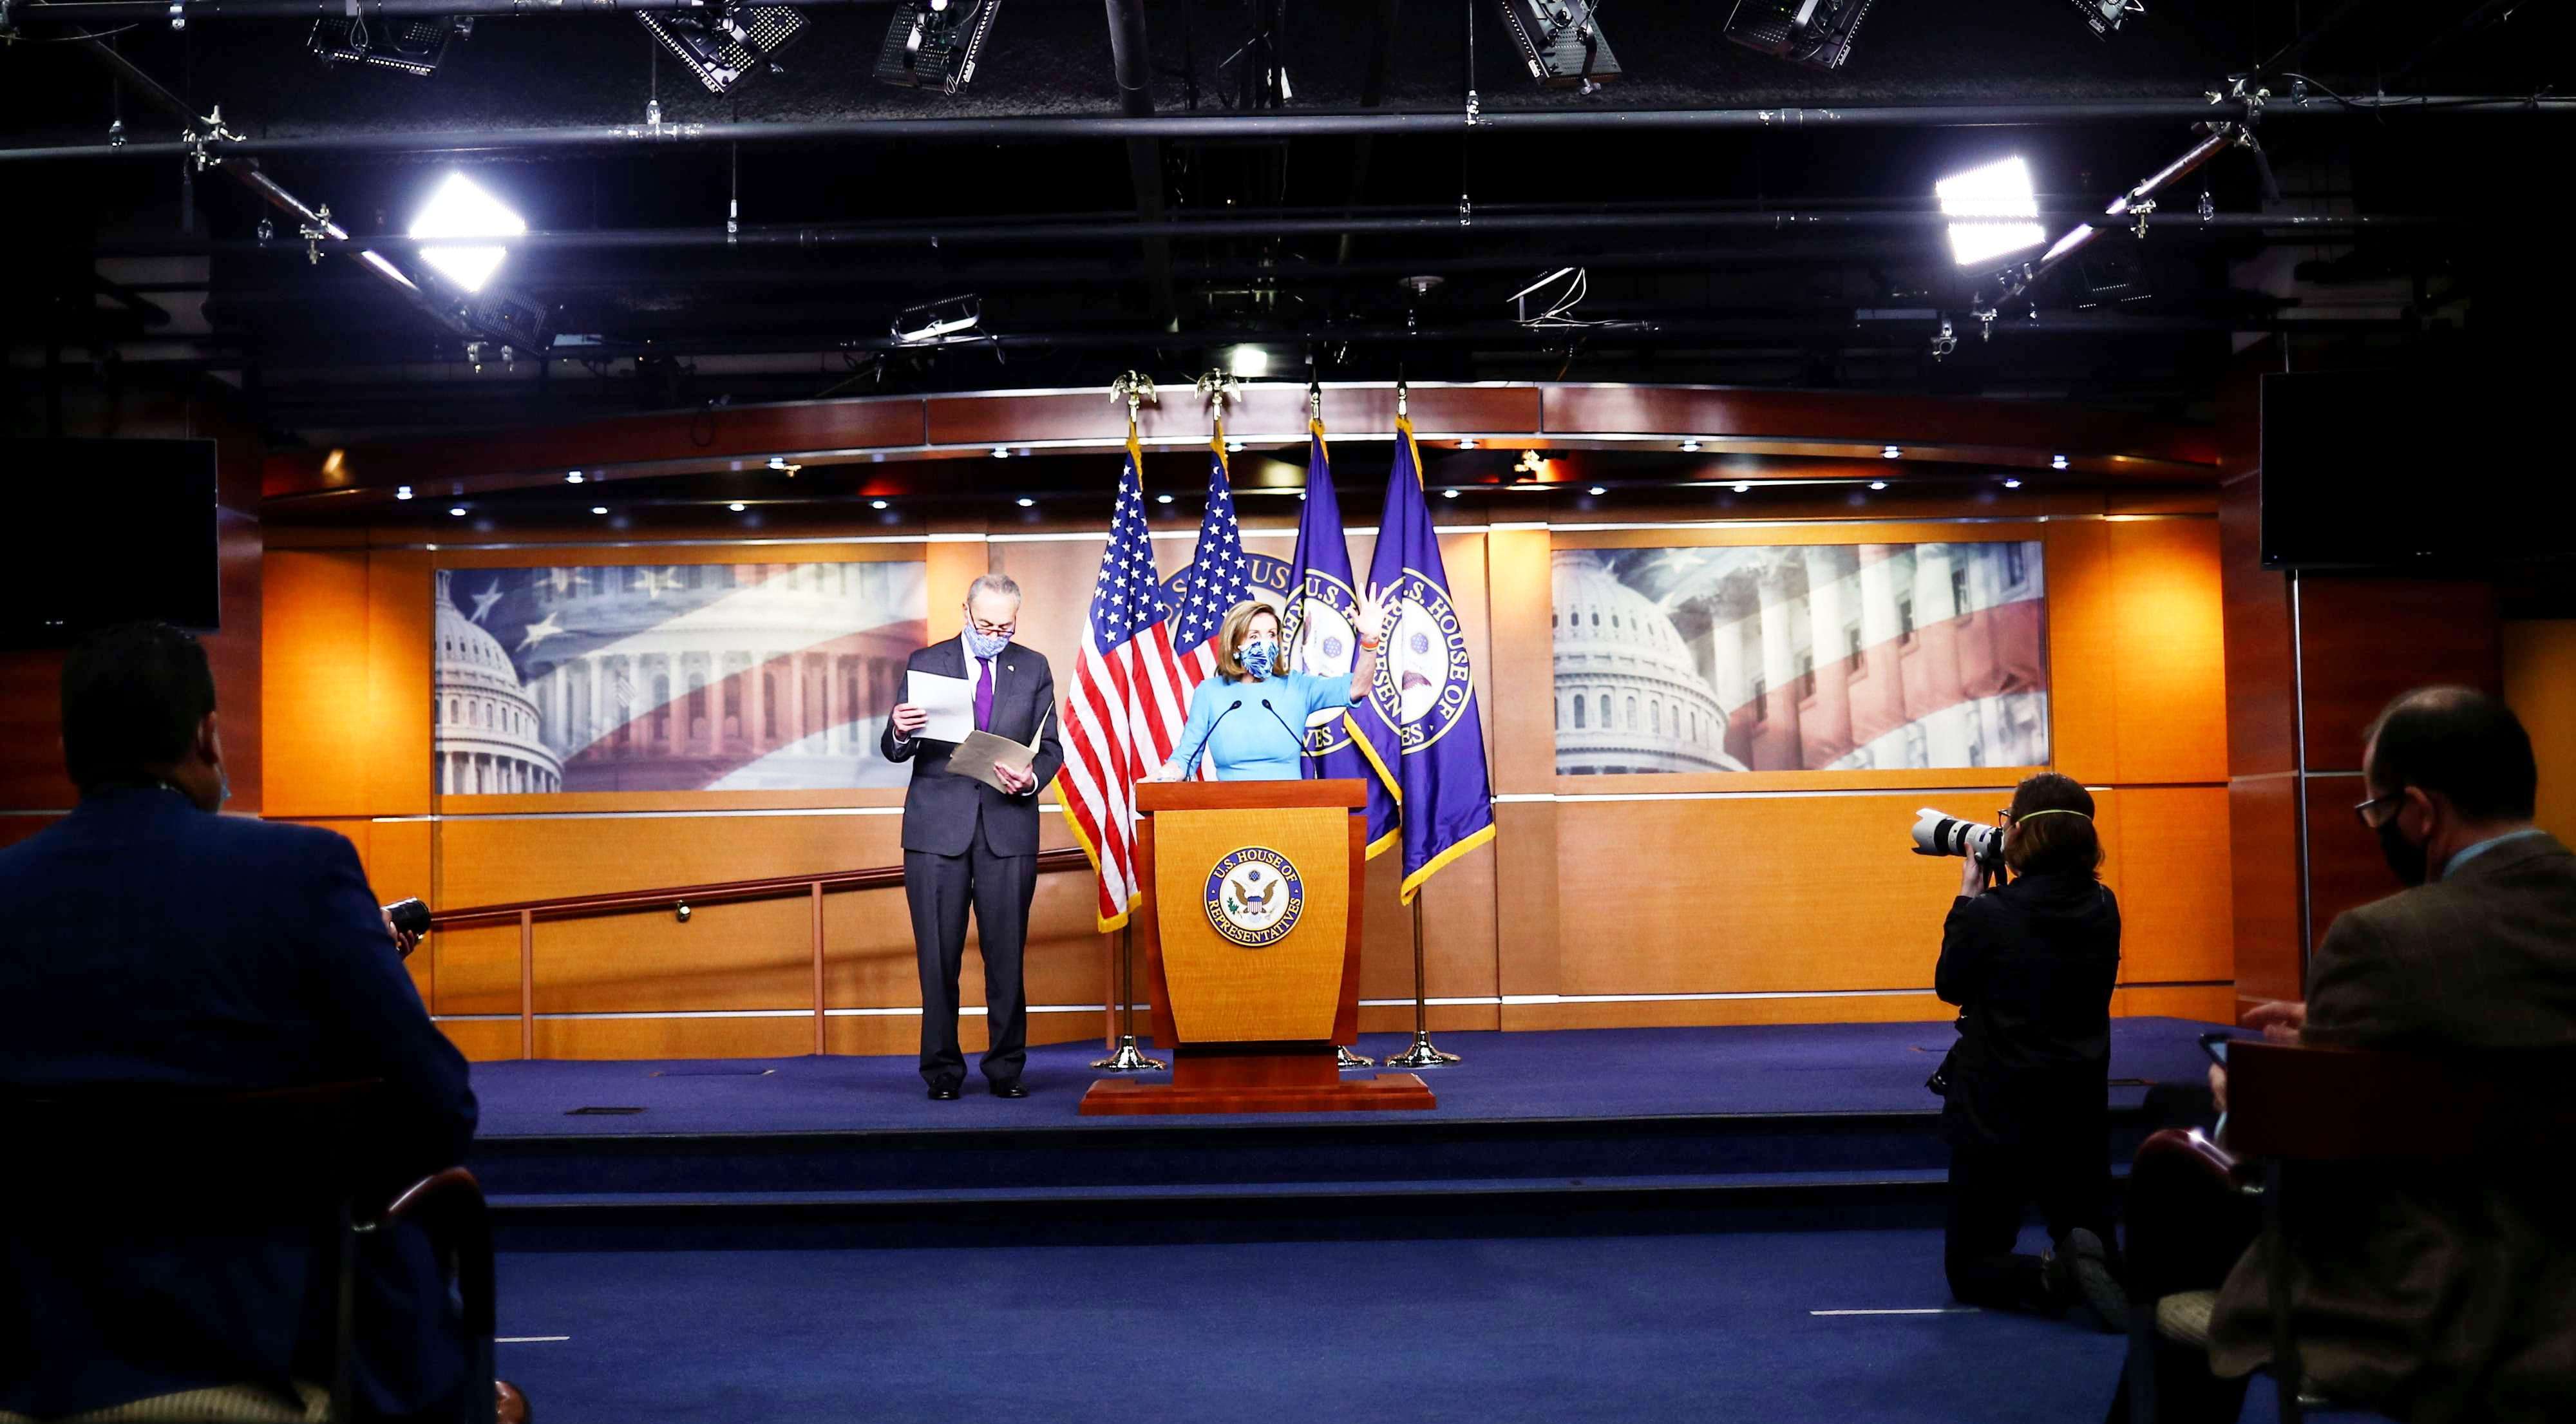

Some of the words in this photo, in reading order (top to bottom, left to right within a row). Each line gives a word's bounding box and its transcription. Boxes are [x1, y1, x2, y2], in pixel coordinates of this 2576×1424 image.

[1305, 577, 1339, 609] U.S.
[1403, 582, 1425, 605] .S.
[1427, 596, 1469, 681] HOUSE
[1438, 685, 1463, 720] OF
[1213, 859, 1236, 878] U.S.
[1236, 850, 1283, 868] HOUSE
[1281, 865, 1297, 882] OF
[1208, 898, 1301, 942] REPRESENTATIVES
